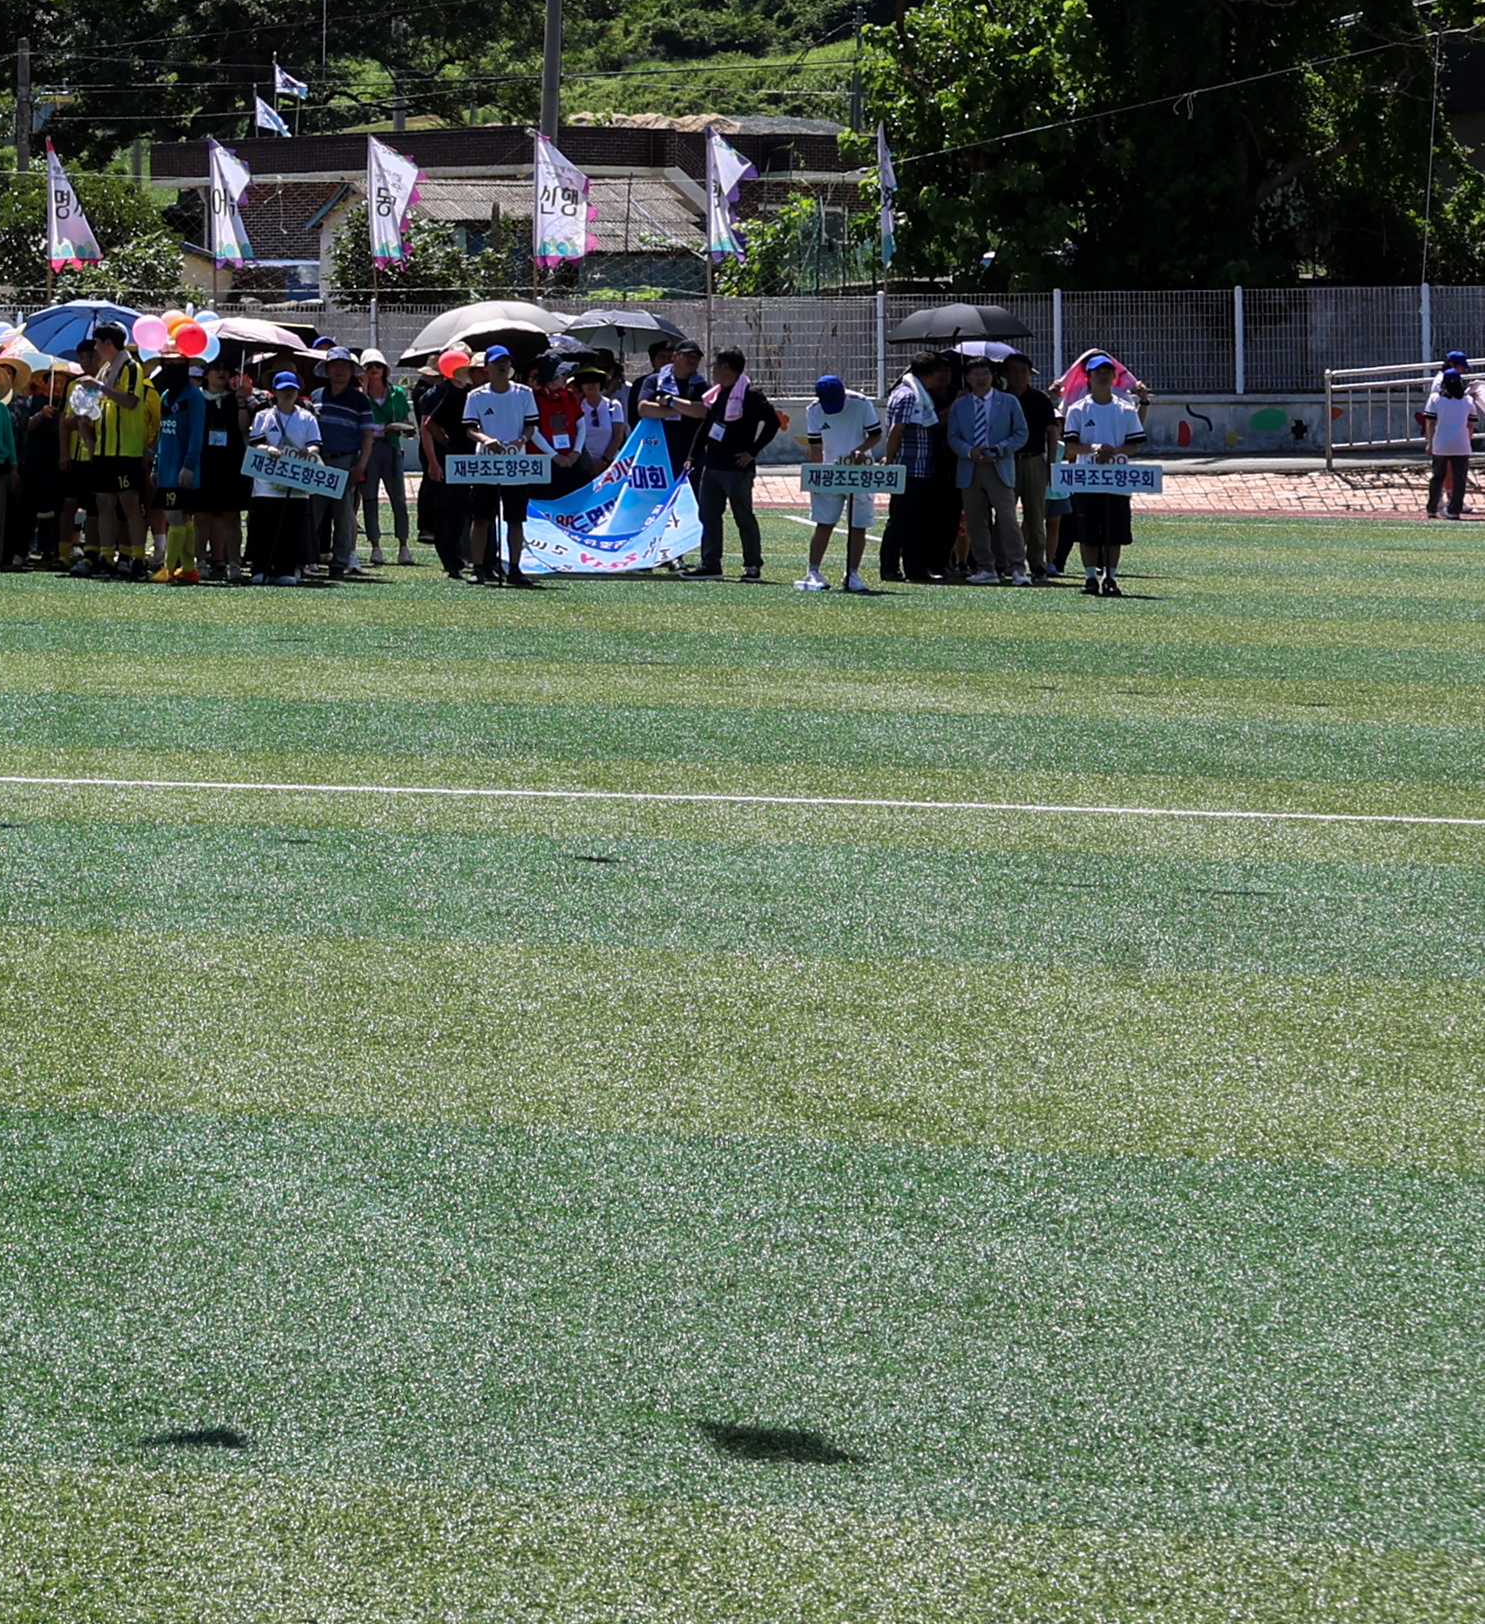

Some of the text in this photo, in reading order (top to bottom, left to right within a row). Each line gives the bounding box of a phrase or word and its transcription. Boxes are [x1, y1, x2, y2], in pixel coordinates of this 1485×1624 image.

[454, 460, 543, 477] 재부조도향우회
[835, 456, 875, 466] JOO
[251, 453, 340, 491] 재경조도향우회
[808, 469, 898, 488] 재광조도향우회
[1060, 469, 1155, 488] 재목조도향우회
[118, 477, 129, 489] 16
